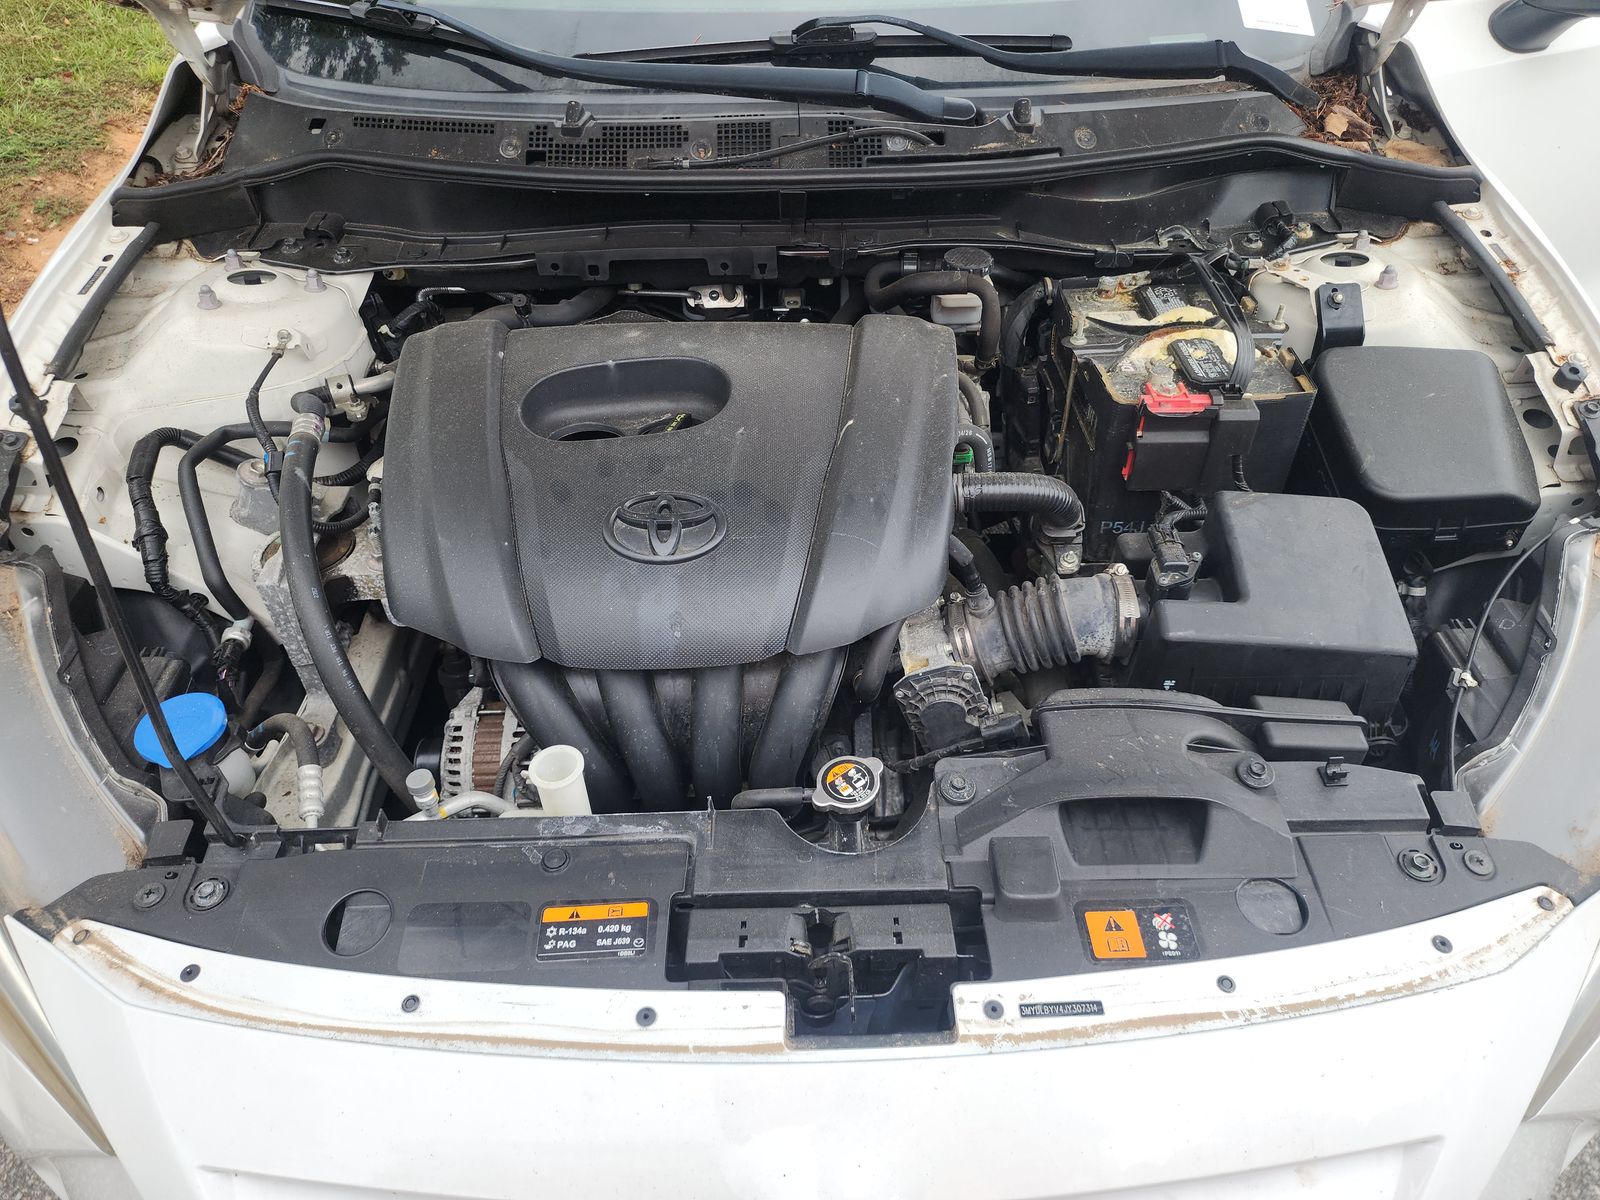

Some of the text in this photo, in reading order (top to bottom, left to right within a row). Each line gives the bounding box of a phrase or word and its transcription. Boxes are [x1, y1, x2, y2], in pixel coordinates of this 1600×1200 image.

[558, 926, 587, 936] R-134a
[597, 923, 632, 933] 0.420 kg
[556, 939, 577, 949] PAG
[596, 938, 613, 947] SAE
